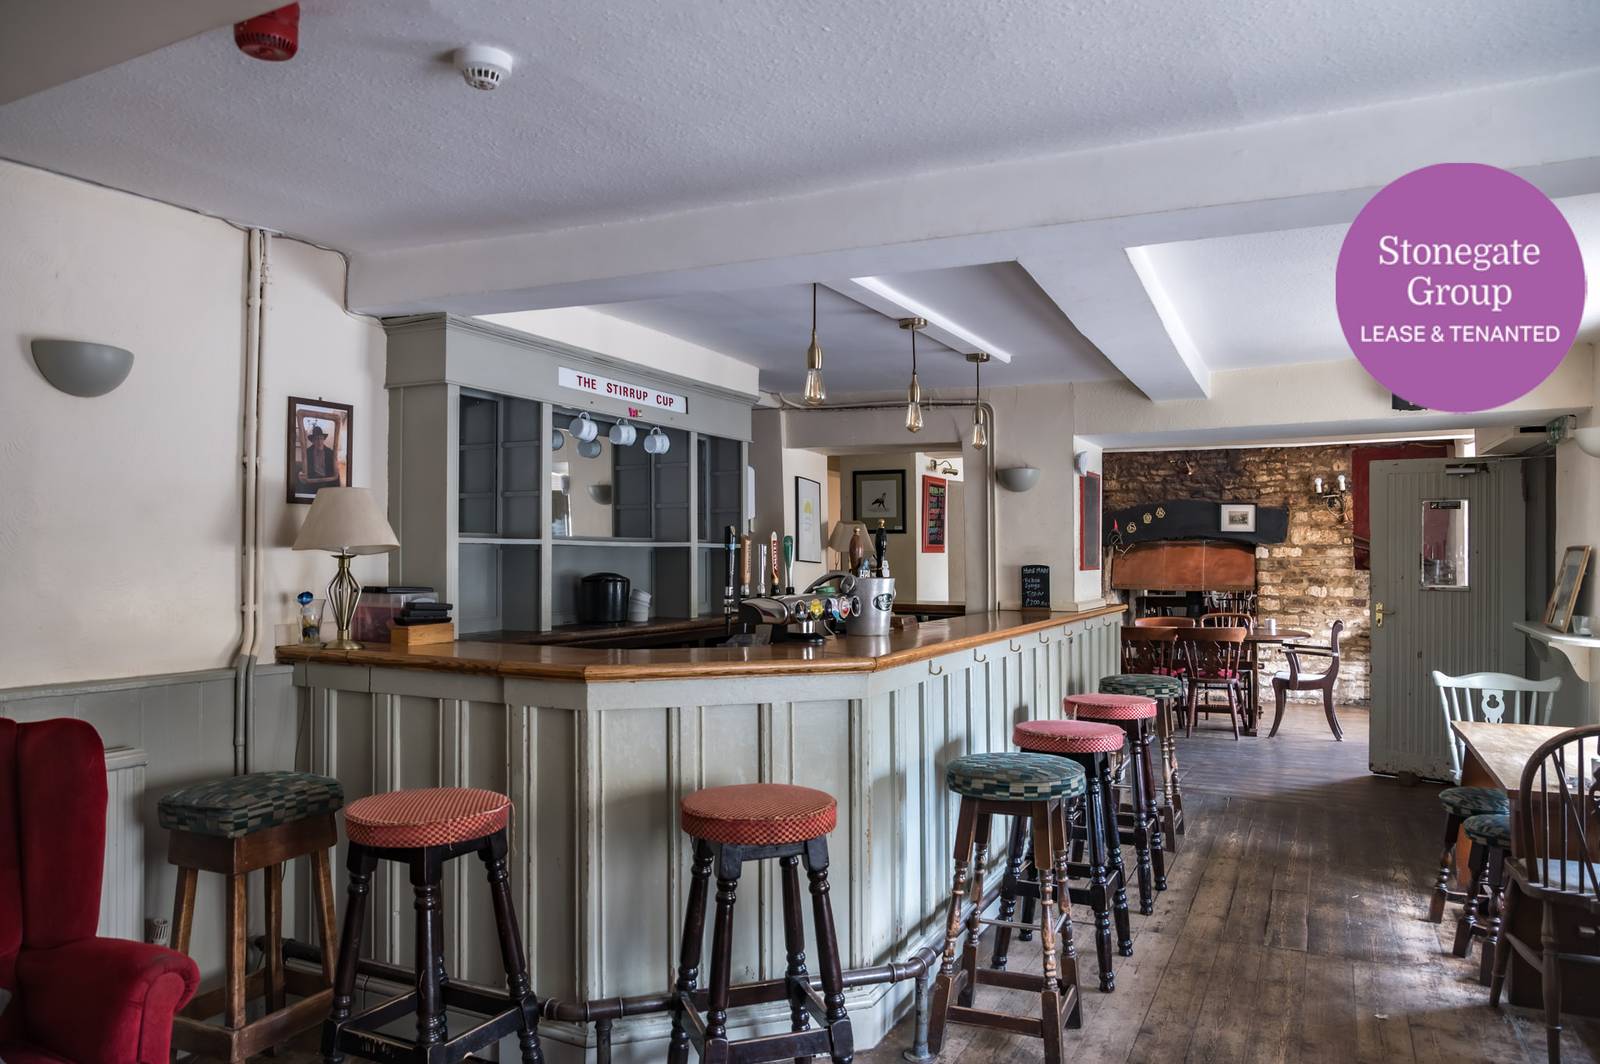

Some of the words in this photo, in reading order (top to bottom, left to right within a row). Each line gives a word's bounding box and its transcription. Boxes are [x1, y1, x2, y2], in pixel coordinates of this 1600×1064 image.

[576, 375, 597, 390] THE
[606, 382, 648, 401] STIRRUP
[656, 394, 675, 408] CUP
